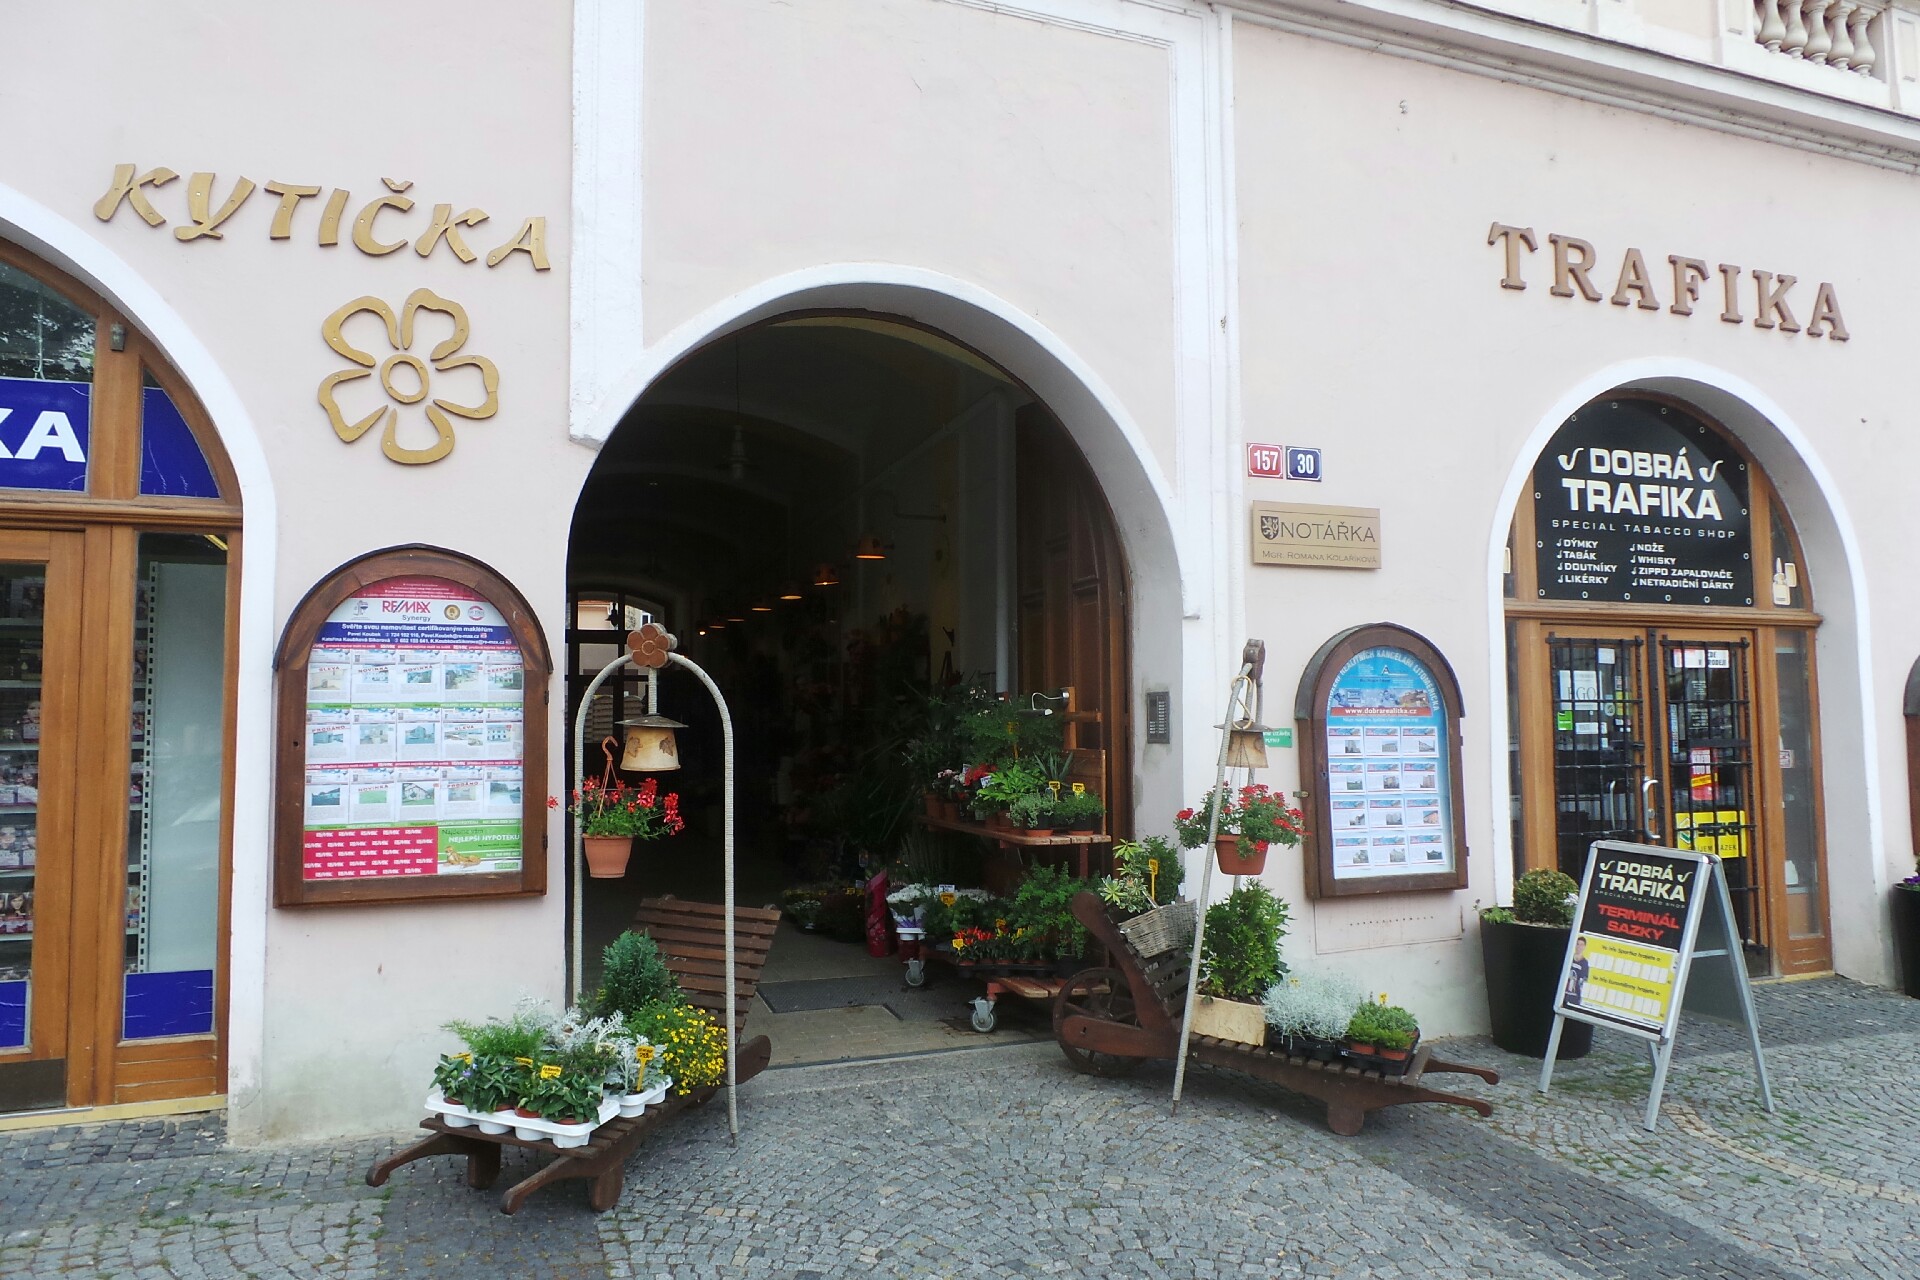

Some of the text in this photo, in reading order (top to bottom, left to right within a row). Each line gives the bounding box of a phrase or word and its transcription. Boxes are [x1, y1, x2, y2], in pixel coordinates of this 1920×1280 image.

[93, 163, 552, 272] KYTIČKA
[1487, 221, 1850, 342] TRAFIKA
[1253, 449, 1279, 471] 157
[1297, 453, 1315, 475] 30
[1589, 446, 1694, 481] DOBRÁ
[1561, 477, 1723, 521] TRAFIKA
[1281, 520, 1377, 543] NOTÁŘKA
[1552, 519, 1736, 539] SPECIAL TABACCO SHOP
[1563, 537, 1599, 549] DÝMKY
[1637, 541, 1665, 553] NOŽE
[1563, 550, 1597, 560] TABÁK
[1637, 555, 1677, 565] WHISKY
[1564, 561, 1618, 574] DOUTNÍKY
[1638, 567, 1733, 580] ZIPPO ZAPALOVAČE
[1564, 573, 1610, 585] LIKÉRKY
[1639, 578, 1735, 591] NETRADIČNÍ DÁRKY
[402, 614, 431, 622] Synergy
[1345, 707, 1417, 715] www.dobrarealitka.cz
[1616, 860, 1674, 881] DOBRÁ
[1594, 889, 1625, 899] SPECIAL
[1598, 872, 1686, 902] TRAFIKA
[1598, 903, 1680, 929] TERMINÁL
[1607, 920, 1664, 940] SAZKY
